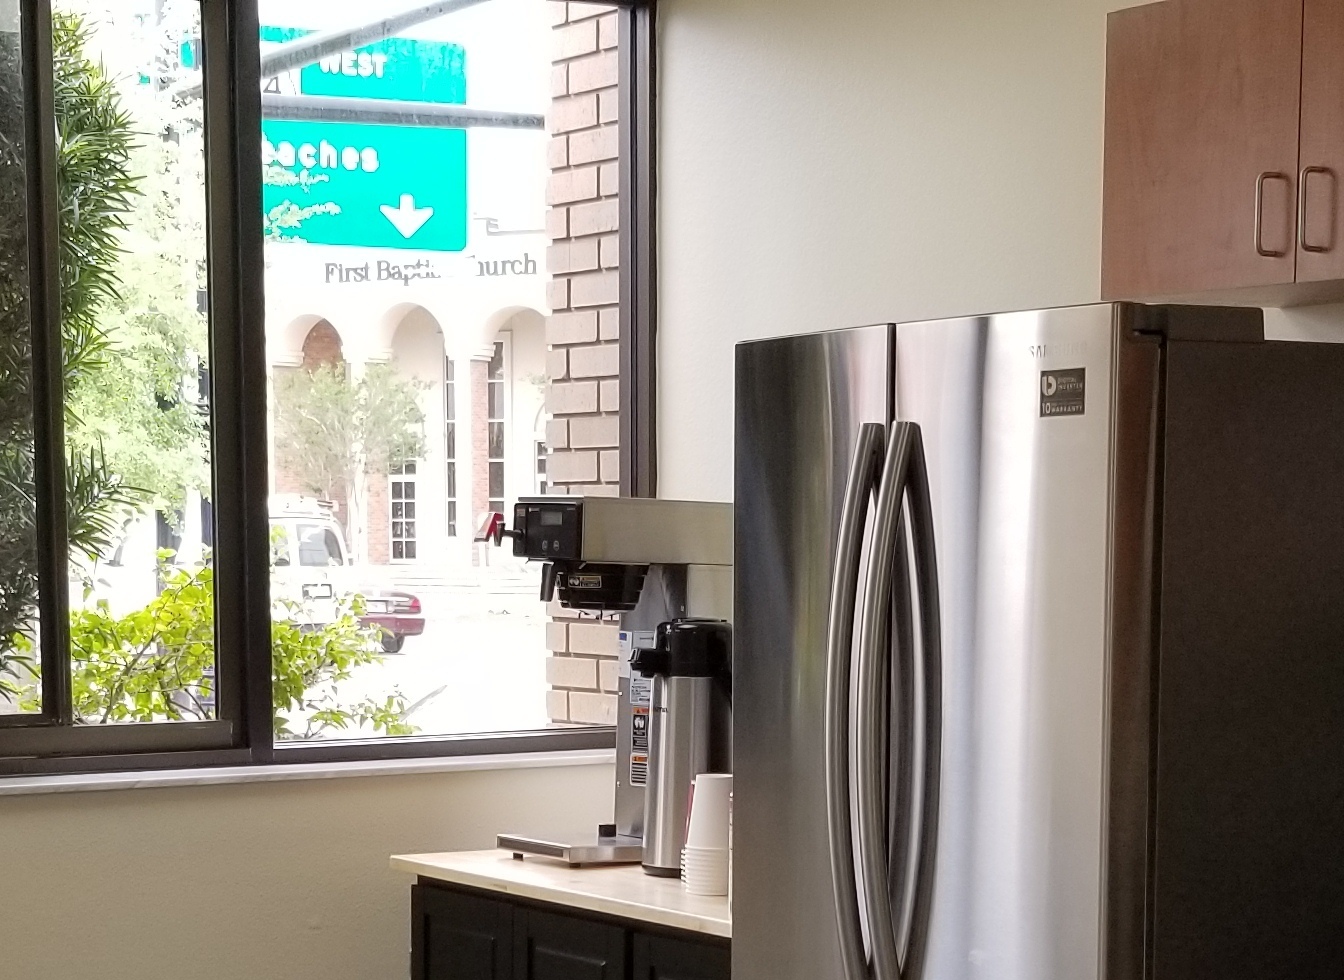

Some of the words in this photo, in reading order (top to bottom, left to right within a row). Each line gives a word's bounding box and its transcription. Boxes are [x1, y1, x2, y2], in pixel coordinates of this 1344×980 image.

[318, 52, 388, 79] WEST
[261, 138, 380, 174] eaches
[324, 261, 371, 284] First
[1042, 402, 1051, 414] 10
